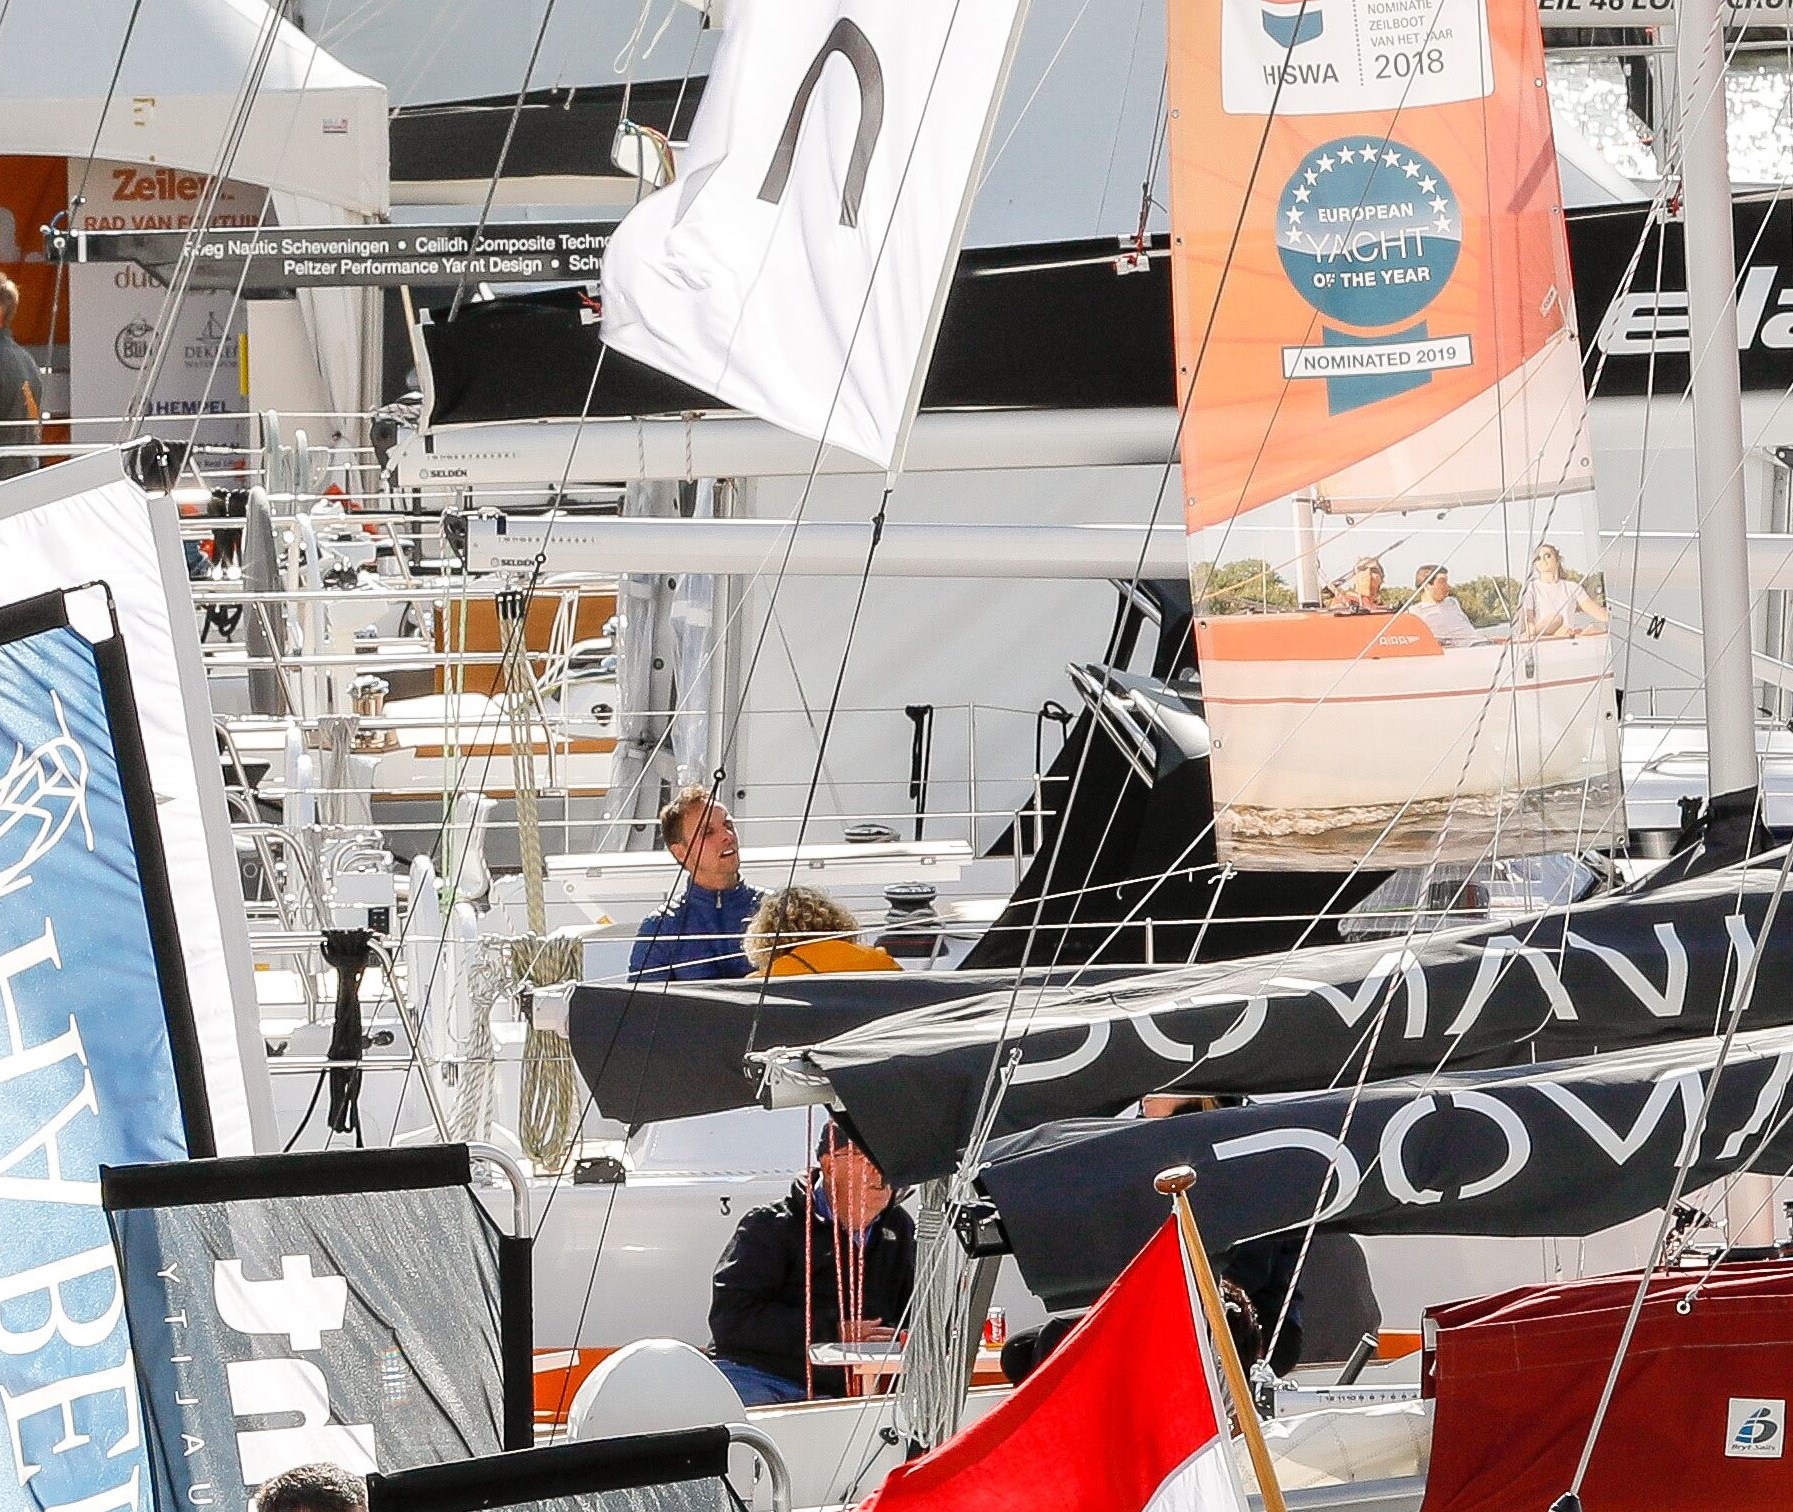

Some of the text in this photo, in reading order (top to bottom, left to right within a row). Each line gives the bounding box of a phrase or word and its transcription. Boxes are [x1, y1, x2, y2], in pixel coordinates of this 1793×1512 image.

[1368, 0, 1432, 14] NOMINATIE
[1369, 15, 1425, 31] ZEILBOOT
[1370, 28, 1453, 47] VAN HET JAAR
[1374, 48, 1445, 80] 2018
[1262, 63, 1340, 86] HISWA
[1317, 202, 1414, 223] EUROPEAN
[84, 216, 125, 230] RAD
[132, 216, 172, 229] VAN
[282, 237, 389, 255] Scheveningen
[1304, 225, 1430, 264] YACHT
[284, 259, 337, 276] Peltzer
[340, 257, 438, 275] Performance
[489, 256, 542, 276] Design
[1313, 266, 1430, 288] OF THE YEAR
[1303, 345, 1457, 371] NOMINATED 2019
